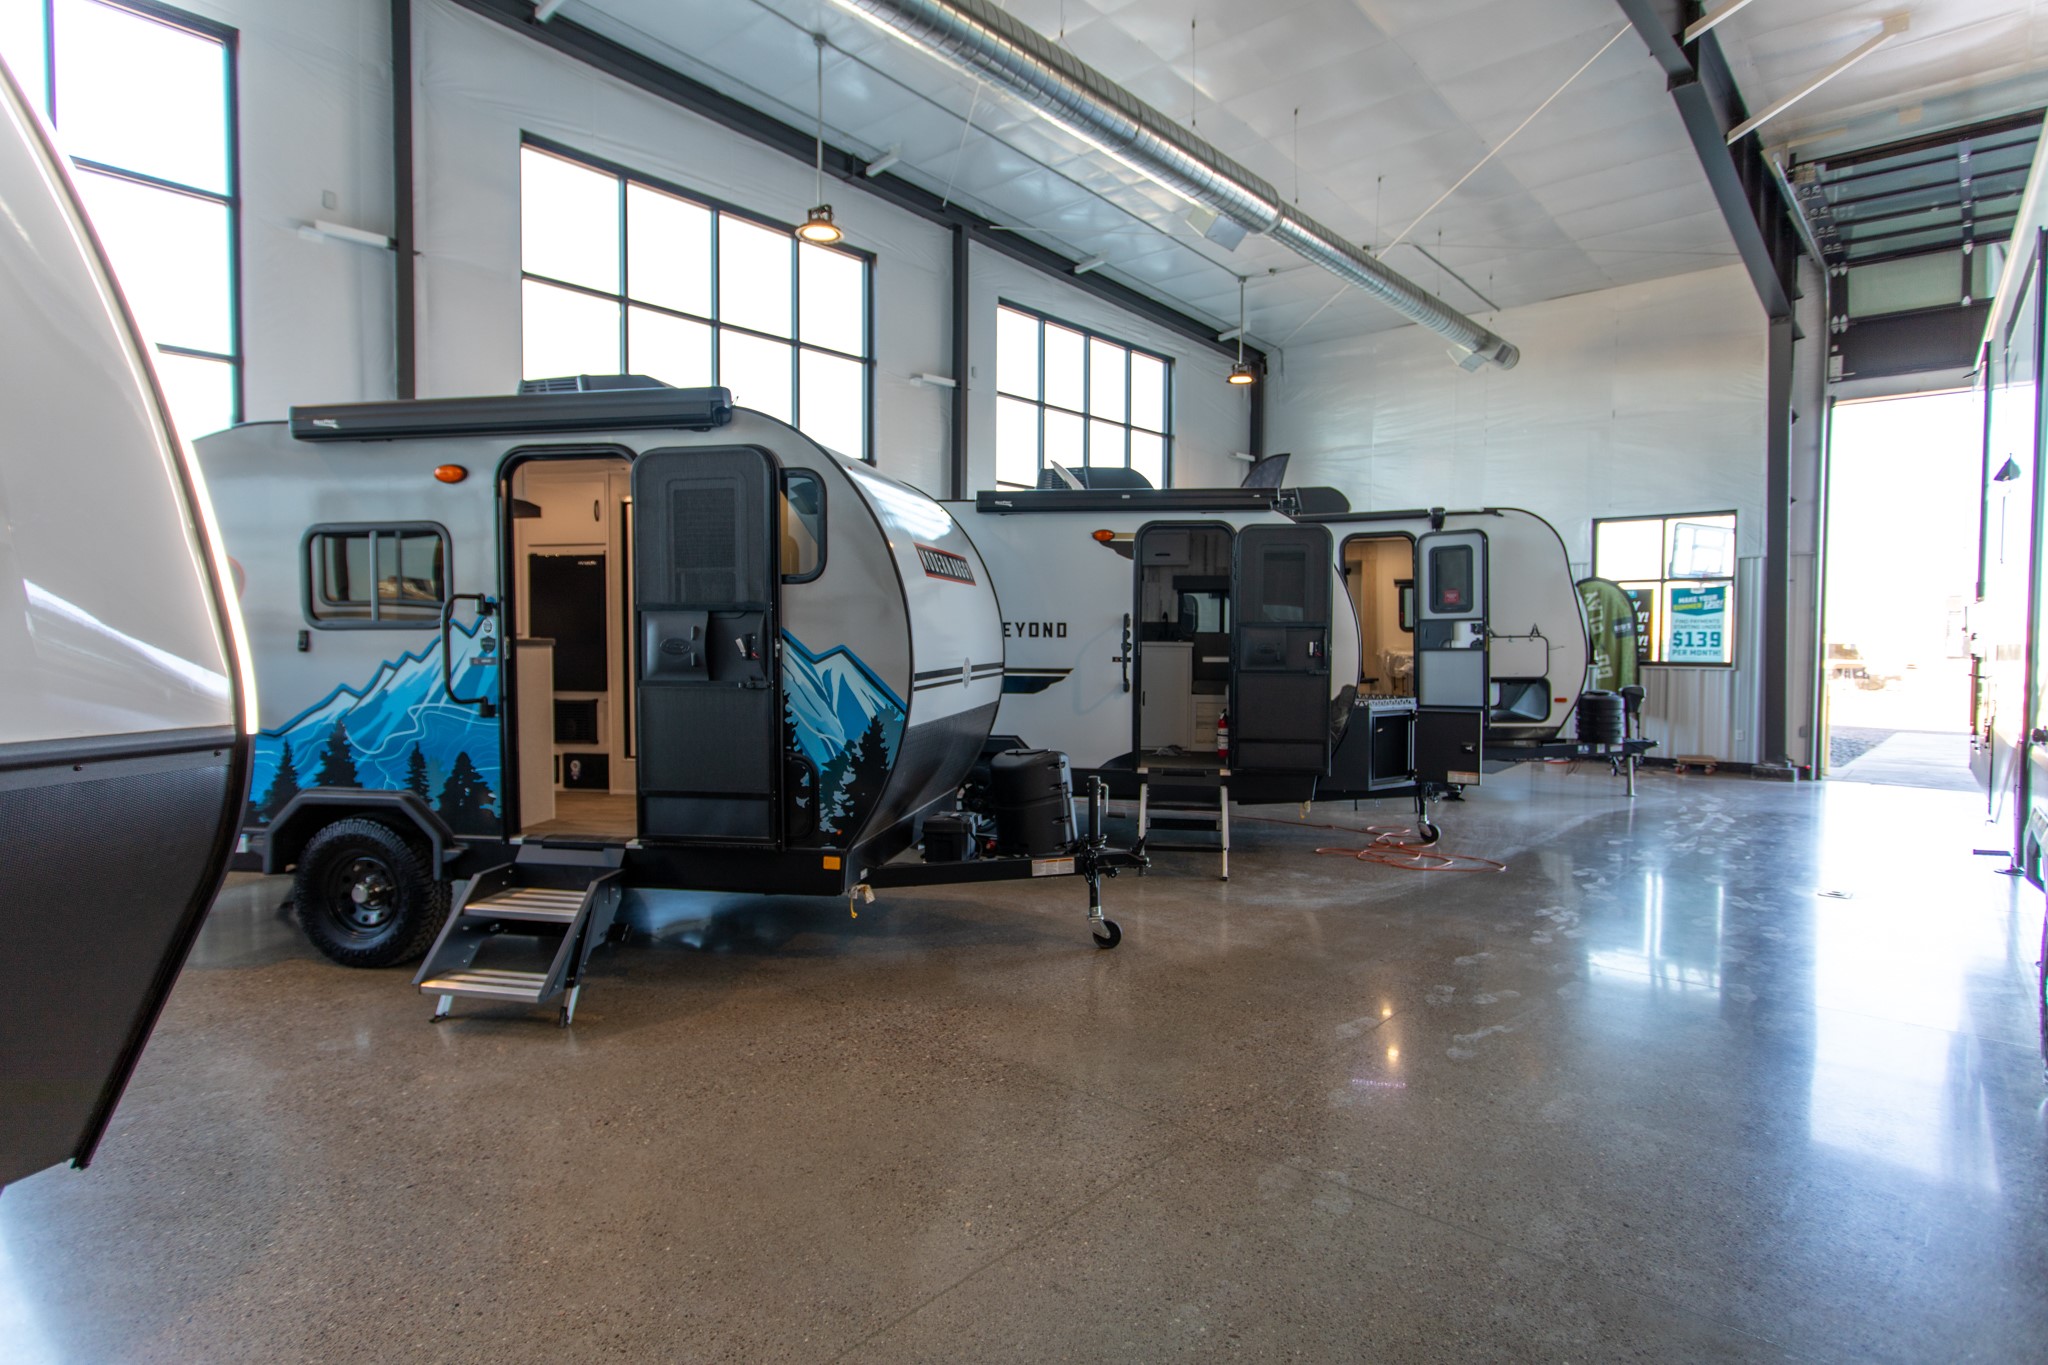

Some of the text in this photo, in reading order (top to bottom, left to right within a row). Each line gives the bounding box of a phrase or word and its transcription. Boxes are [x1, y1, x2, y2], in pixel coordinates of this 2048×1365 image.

[917, 548, 953, 575] MODERN
[1585, 591, 1603, 634] PLAY
[1003, 622, 1066, 637] EYOND
[1672, 630, 1721, 648] $139
